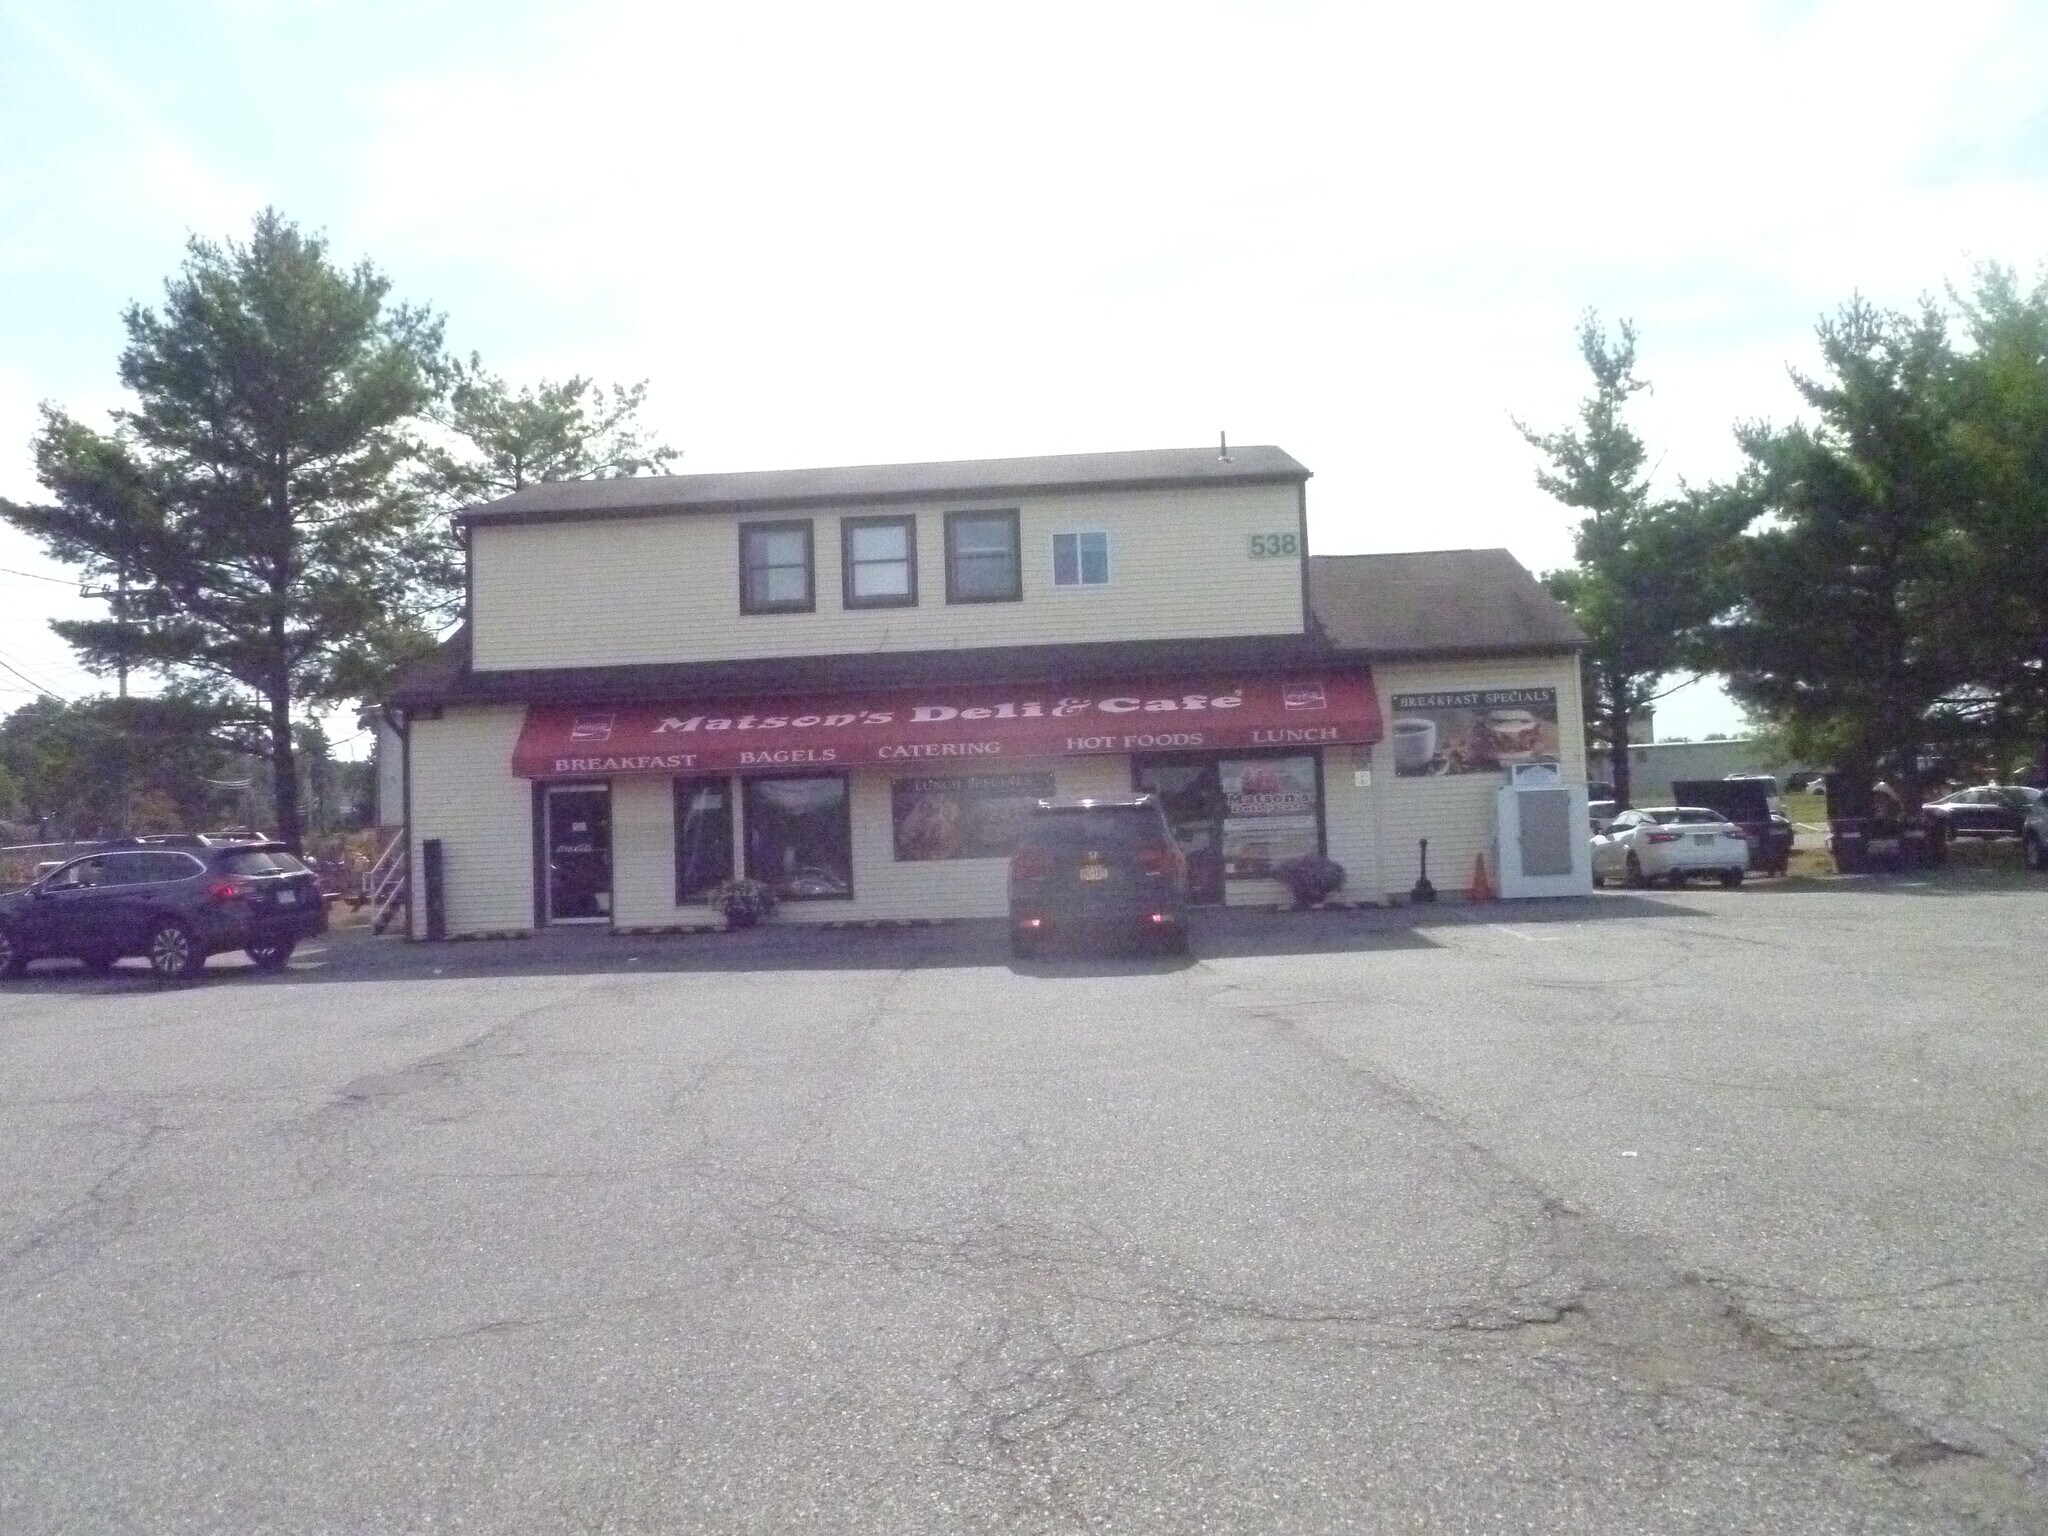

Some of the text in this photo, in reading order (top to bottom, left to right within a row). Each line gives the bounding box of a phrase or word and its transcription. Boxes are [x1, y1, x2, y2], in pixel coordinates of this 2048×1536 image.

[1251, 534, 1296, 555] 538
[1402, 690, 1549, 707] BREAKFAST SPECIALS
[651, 710, 895, 733] Matson's
[910, 702, 1044, 722] Deli
[1051, 697, 1092, 717] &
[555, 727, 1338, 771] BREAKFAST BAGELS CATERING HOT FOODS LUNCH
